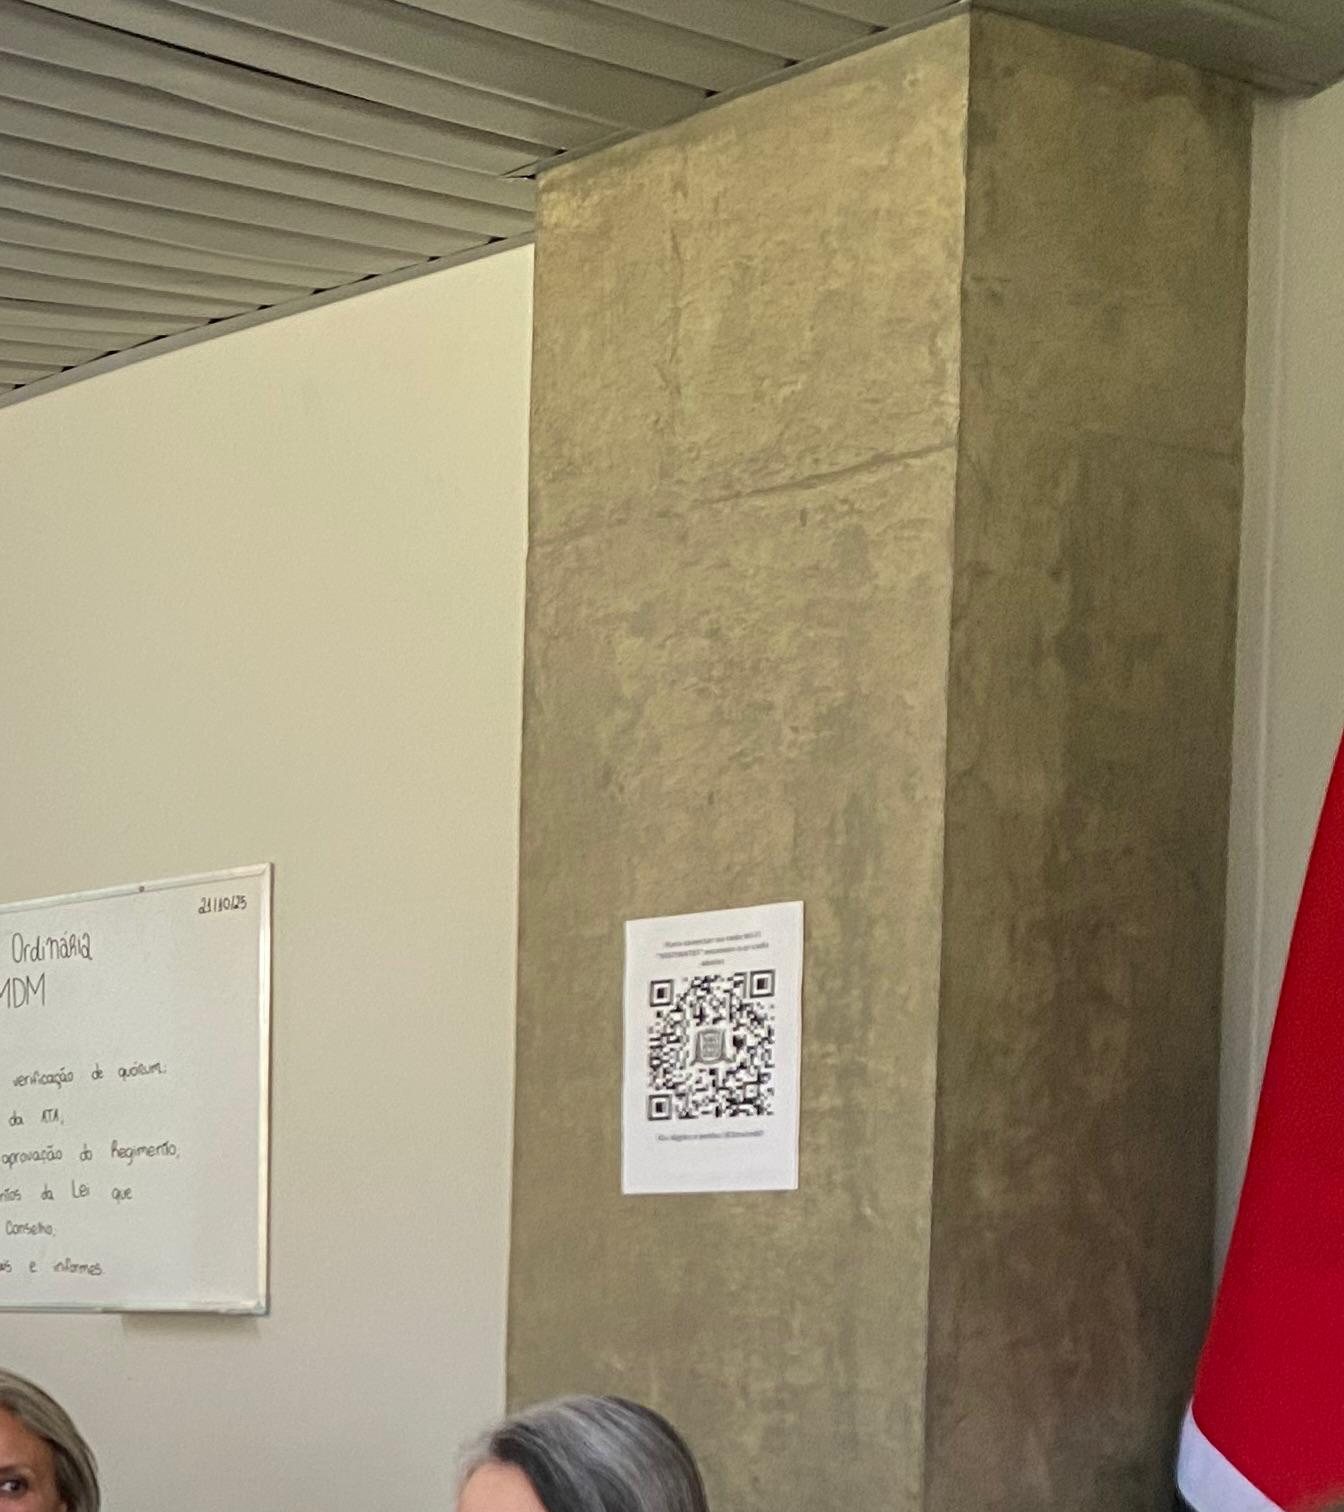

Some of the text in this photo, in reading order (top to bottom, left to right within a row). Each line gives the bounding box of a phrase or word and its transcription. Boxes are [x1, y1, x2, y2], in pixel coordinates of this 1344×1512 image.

[12, 930, 93, 963] Ordinária
[12, 1066, 74, 1090] verificação
[92, 1062, 104, 1080] de
[8, 1110, 24, 1127] da
[1, 1144, 63, 1169] aprovação
[79, 1143, 92, 1161] do
[41, 1183, 54, 1200] da
[72, 1179, 90, 1198] Lei
[111, 1187, 133, 1204] que
[29, 1260, 37, 1273] e
